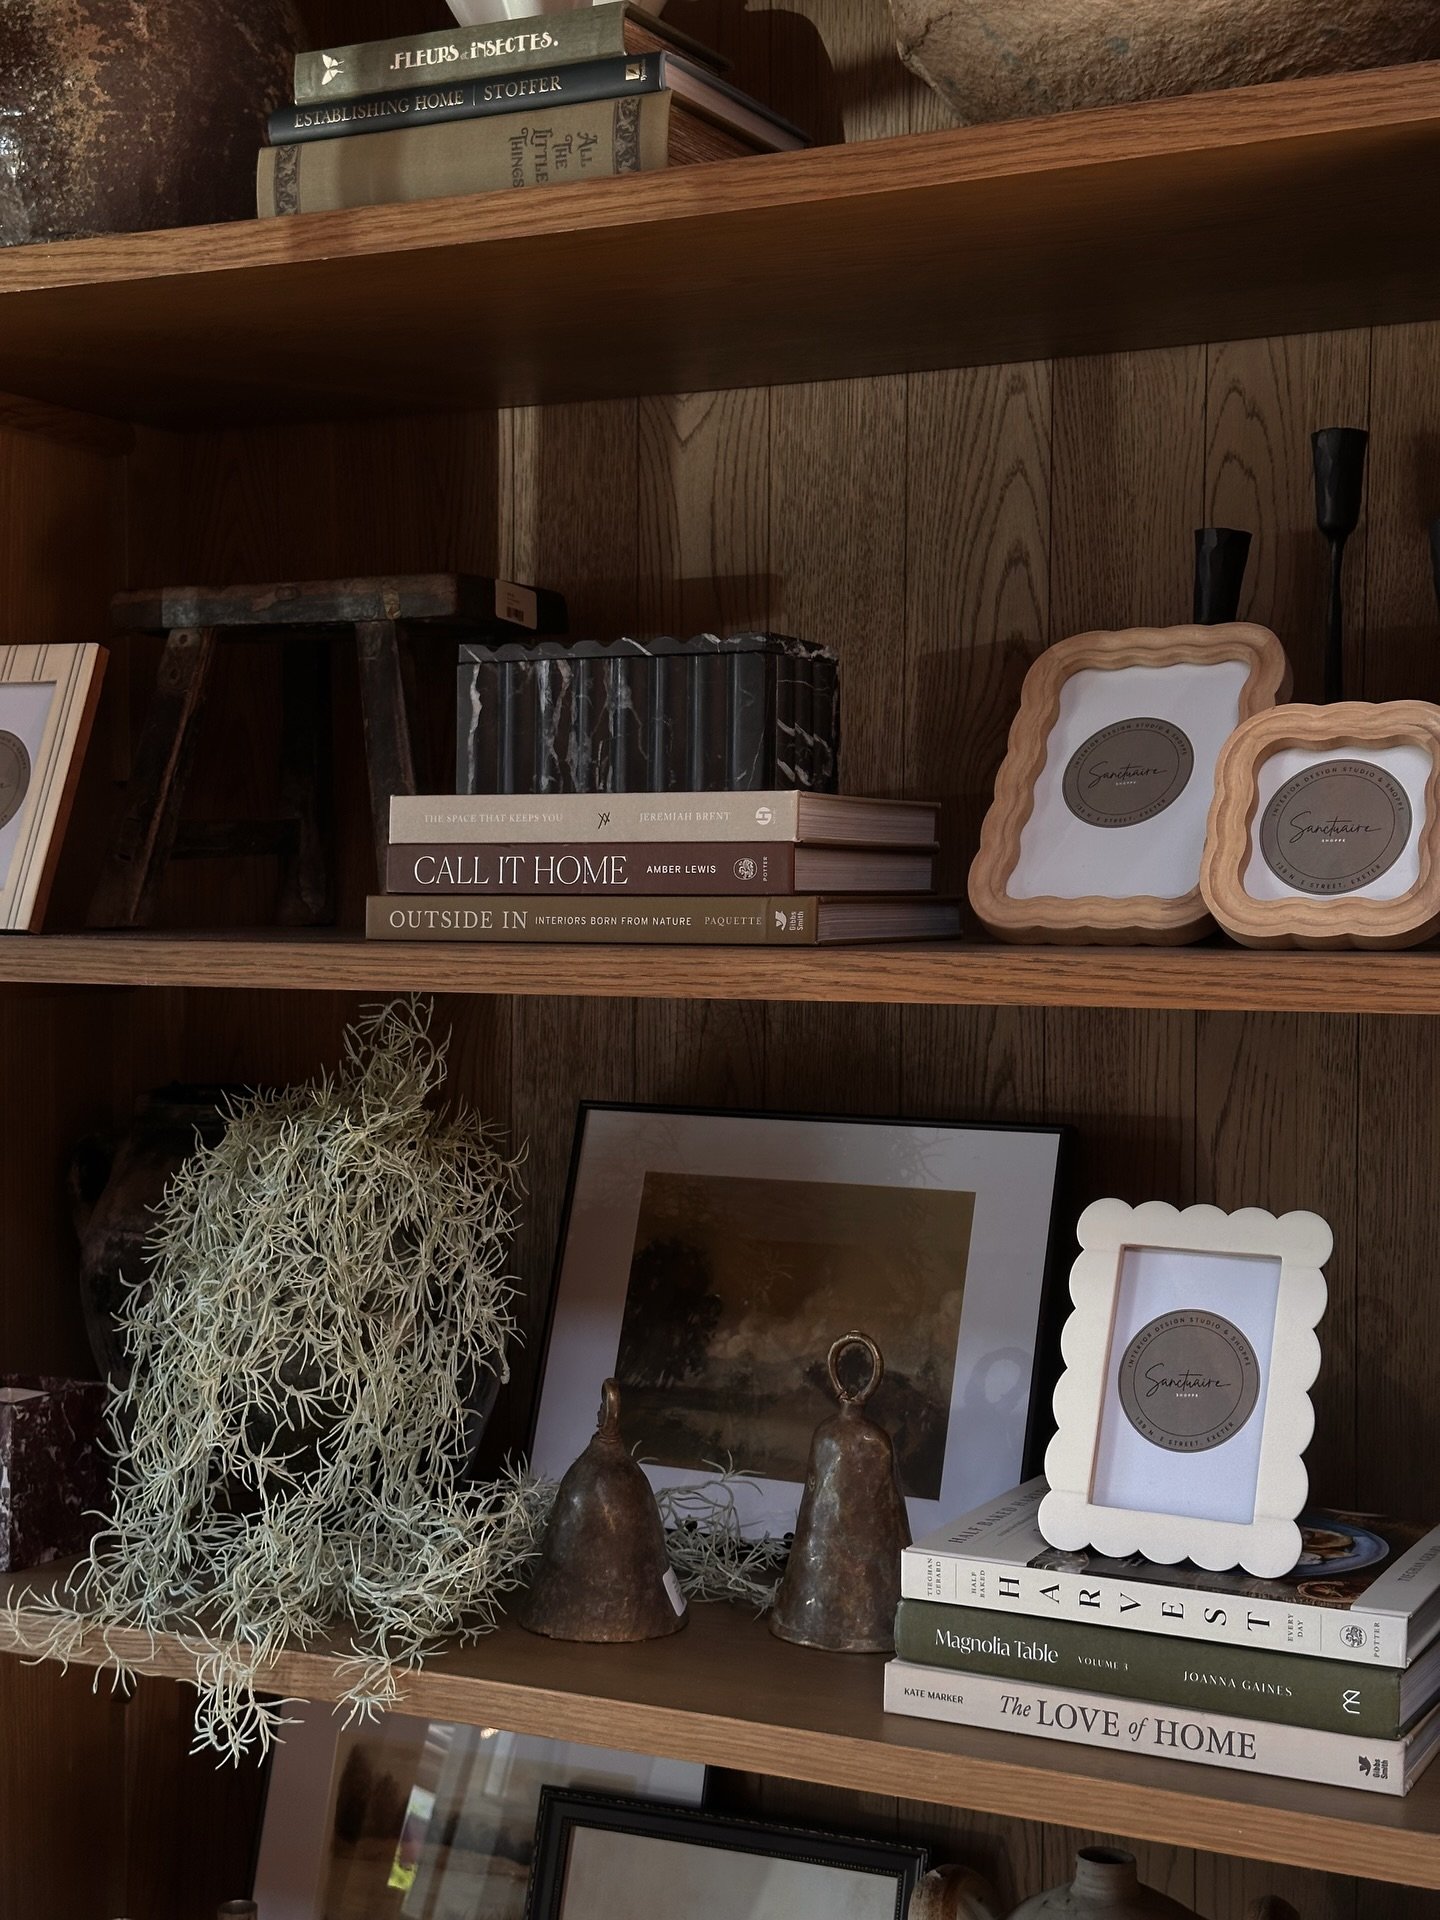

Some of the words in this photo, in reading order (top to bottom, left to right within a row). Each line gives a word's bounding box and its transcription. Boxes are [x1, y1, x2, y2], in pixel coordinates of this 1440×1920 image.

[294, 98, 410, 129] ESTABLISHING
[414, 90, 464, 112] HOME
[483, 75, 563, 101] STOFFER
[1272, 782, 1301, 817] INTERIOR
[1303, 767, 1338, 783] DESIGN
[1342, 766, 1376, 778] STUDIO
[1385, 782, 1405, 812] SHOPPE
[423, 814, 444, 824] THE
[446, 814, 477, 824] SPACE
[479, 814, 507, 823] THAT
[509, 813, 540, 823] KEEPS
[541, 813, 563, 823] YOU
[639, 811, 693, 824] JEREMIAH
[695, 811, 731, 822] BRENT
[1289, 810, 1382, 844] Sanctuaire
[413, 855, 490, 885] CALL
[498, 856, 526, 885] IT
[534, 855, 629, 885] HOME
[646, 865, 682, 874] AMBER
[685, 865, 717, 874] LEWIS
[389, 910, 494, 929] OUTSIDE
[502, 910, 529, 929] IN
[535, 915, 587, 926] INTERIORS
[590, 915, 618, 926] BORN
[621, 916, 649, 926] FROM
[652, 916, 692, 926] NATURE
[704, 915, 762, 927] PAQUETTE
[789, 911, 797, 931] Gibbs
[1128, 1332, 1152, 1368] INTERIOR
[1154, 1317, 1186, 1333] DESIGN
[1189, 1316, 1221, 1329] STUDIO
[1230, 1336, 1251, 1367] SHOPPE
[1144, 1362, 1232, 1398] Sanctuaire
[948, 1526, 983, 1544] HALF
[977, 1506, 1018, 1527] BAKED
[999, 1576, 1270, 1631] HARVEST
[935, 1628, 1010, 1657] Magnolia
[1013, 1640, 1059, 1664] Table
[1077, 1656, 1119, 1671] VOLUME
[1123, 1662, 1129, 1671] 3
[904, 1687, 926, 1698] KATE
[927, 1691, 964, 1704] MARKER
[1183, 1670, 1236, 1689] JOANNA
[1241, 1679, 1293, 1697] GAINES
[1000, 1695, 1032, 1717] The
[1036, 1700, 1120, 1737] LOVE
[1128, 1717, 1149, 1742] of
[1153, 1718, 1257, 1760] HOME
